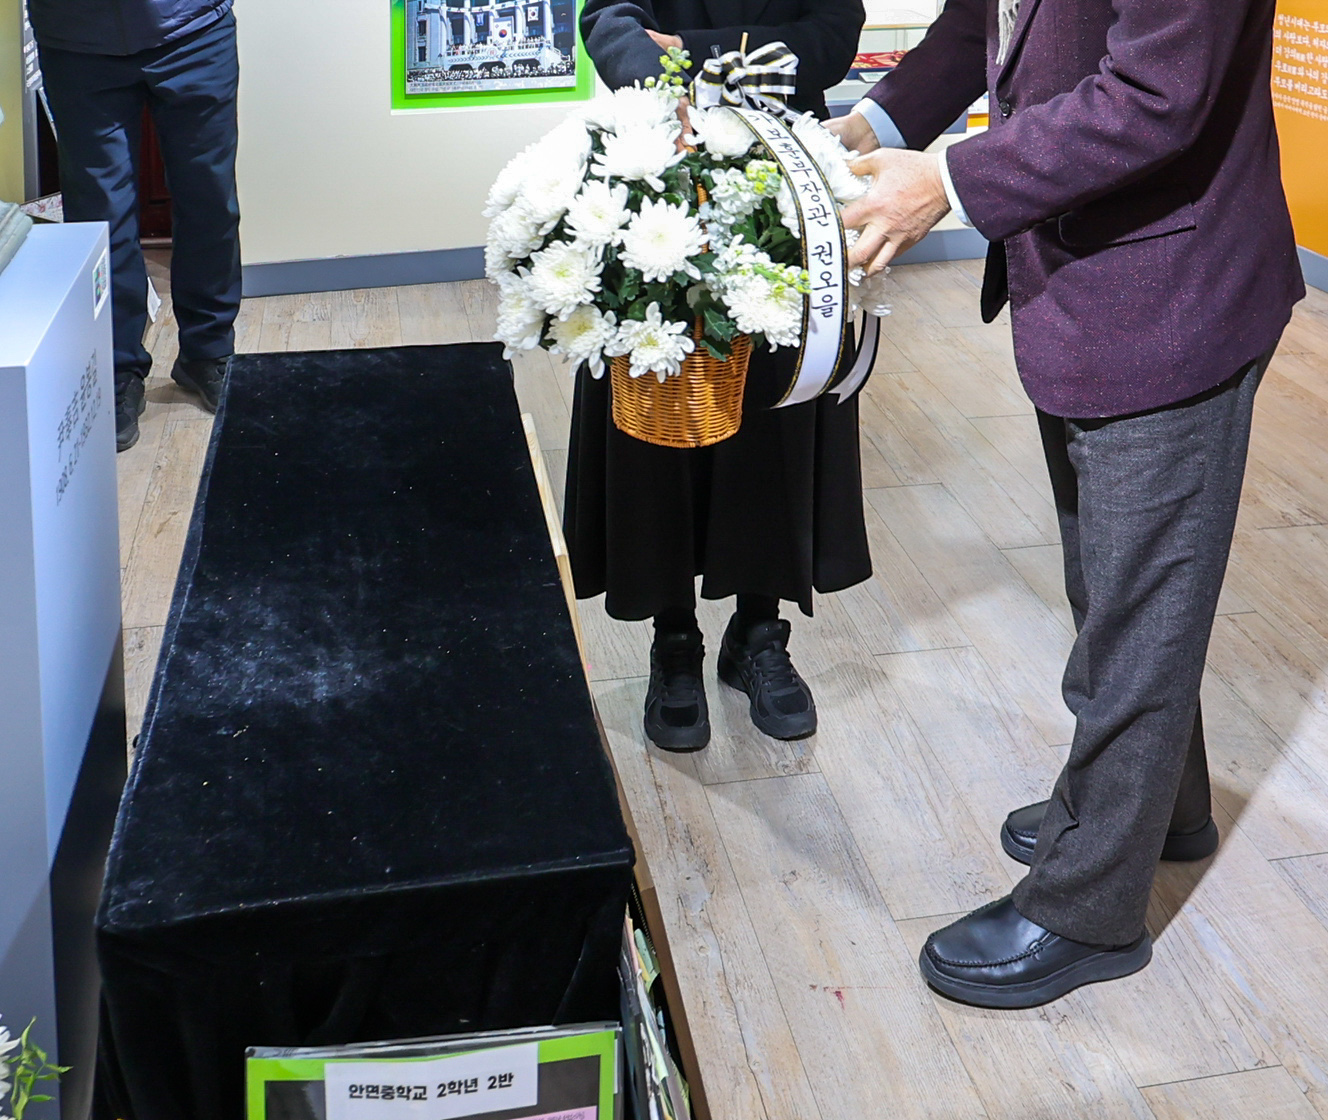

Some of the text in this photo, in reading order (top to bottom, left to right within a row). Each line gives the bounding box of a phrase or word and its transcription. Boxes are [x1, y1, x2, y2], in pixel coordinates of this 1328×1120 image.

[810, 241, 839, 319] 권오을
[348, 1071, 515, 1101] 안면중학교 2학년 2반
